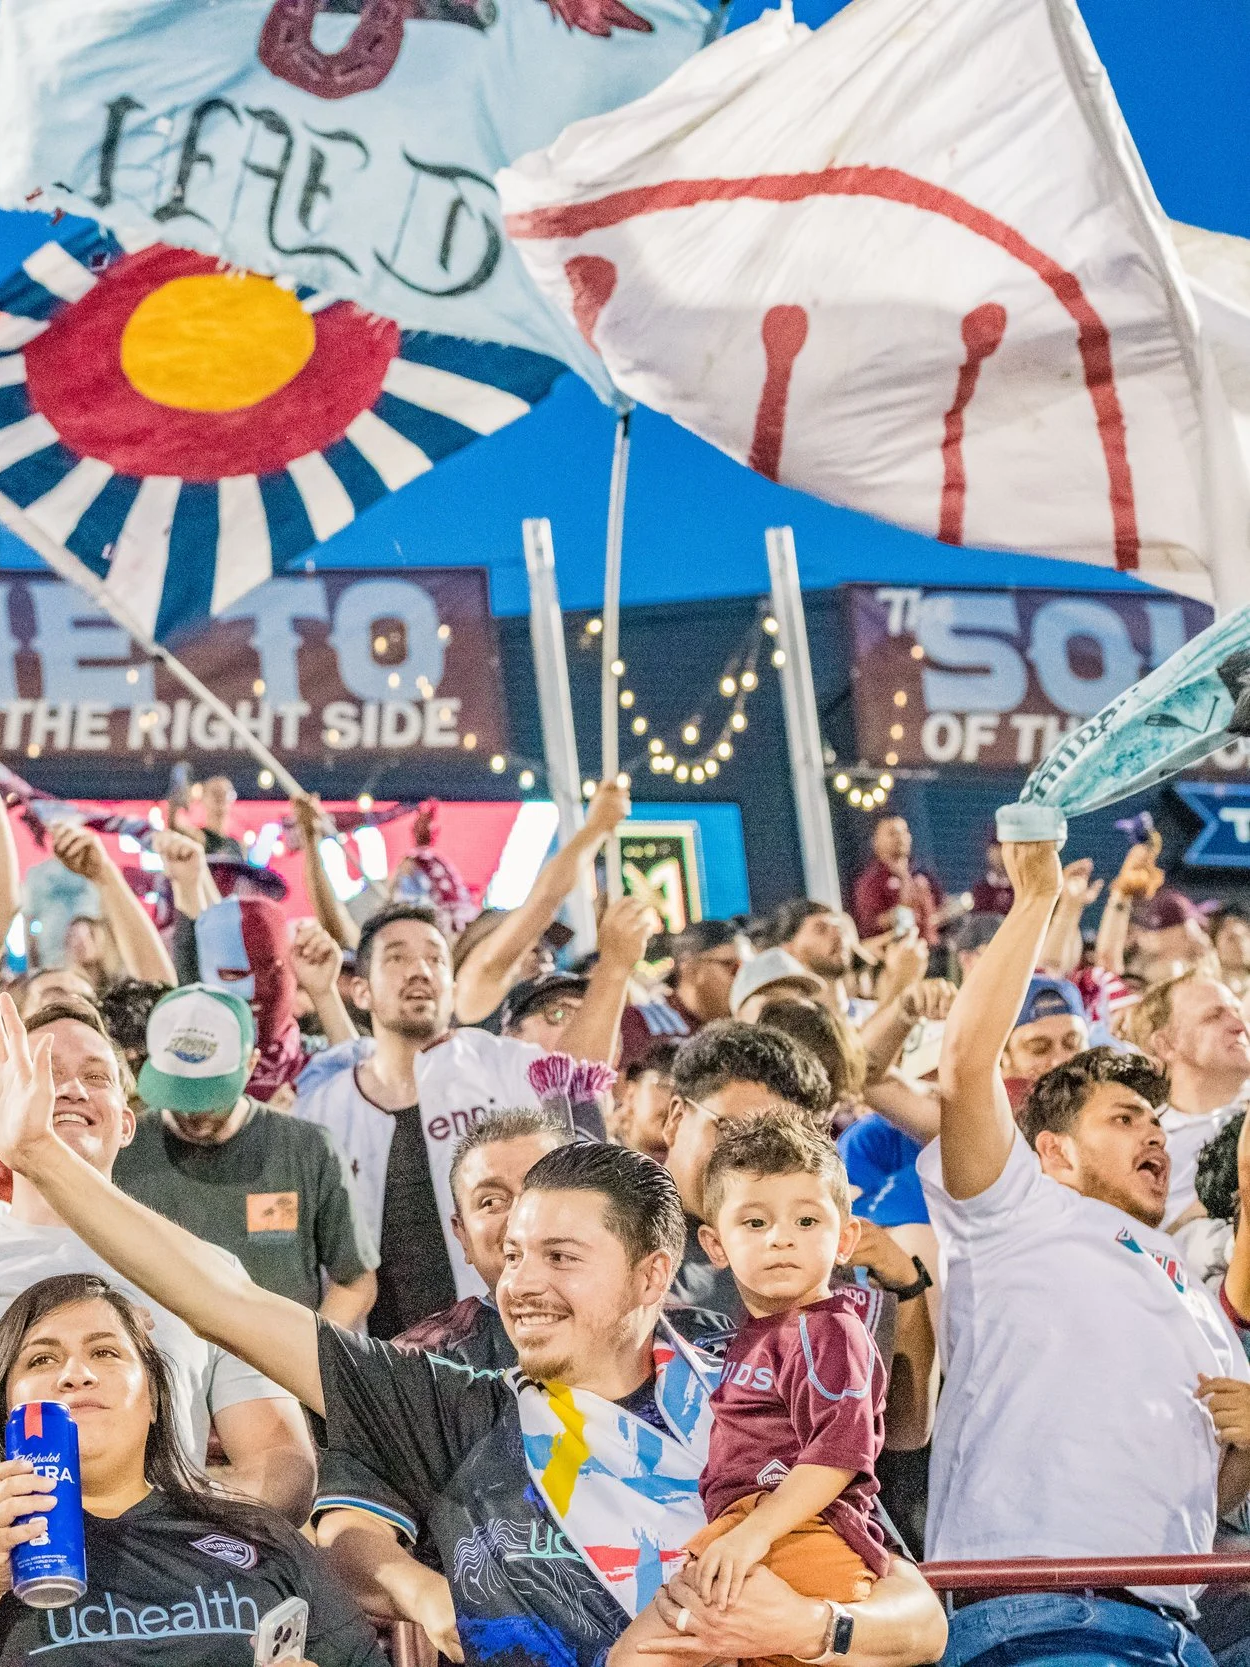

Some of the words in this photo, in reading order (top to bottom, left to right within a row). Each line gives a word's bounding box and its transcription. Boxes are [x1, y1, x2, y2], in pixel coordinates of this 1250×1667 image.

[212, 577, 451, 705] TO
[1, 699, 111, 751] THE
[129, 699, 311, 751] RIGHT
[321, 699, 463, 750] SIDE
[921, 712, 1000, 763] OF
[33, 1464, 73, 1484] TRA
[47, 1581, 260, 1644] uchealth
